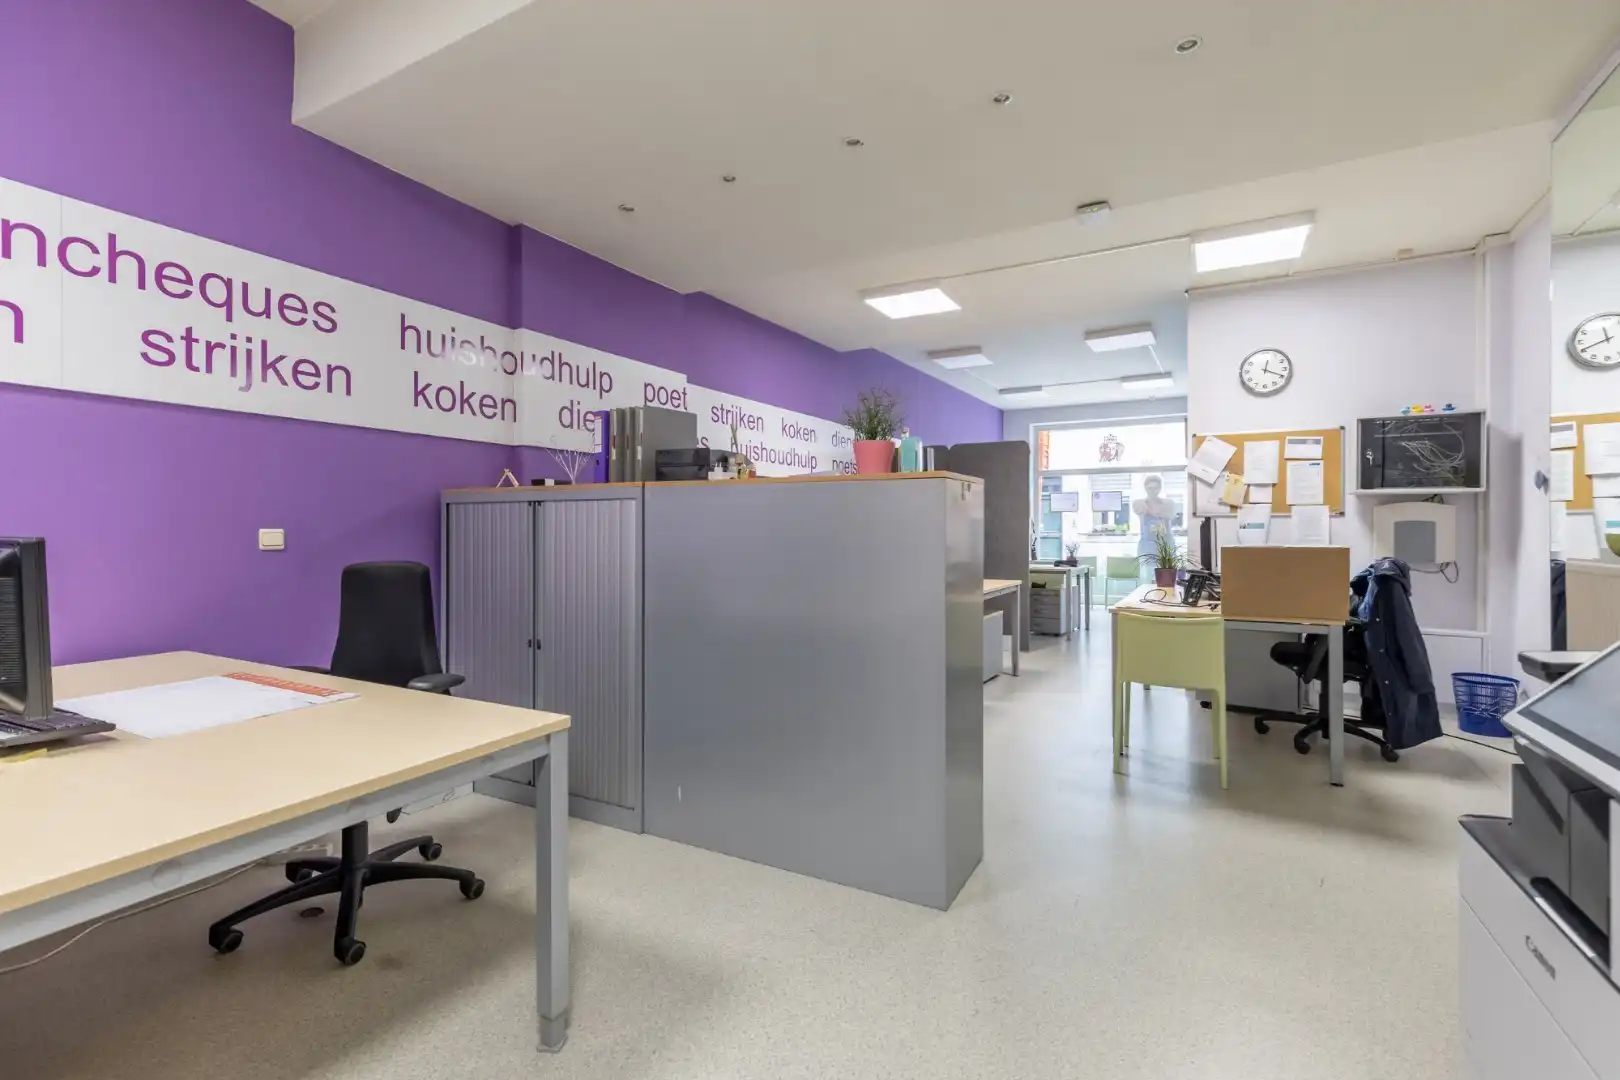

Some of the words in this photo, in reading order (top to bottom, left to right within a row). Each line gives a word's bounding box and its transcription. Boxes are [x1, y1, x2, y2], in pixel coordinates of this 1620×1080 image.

[1, 218, 338, 334] ncheques
[400, 313, 613, 399] huishoudhulp
[644, 382, 687, 410] poet
[140, 326, 352, 396] strijken
[413, 371, 517, 423] koken
[711, 403, 764, 434] strijken
[781, 416, 816, 443] koken
[731, 437, 818, 474] huishoudhulp
